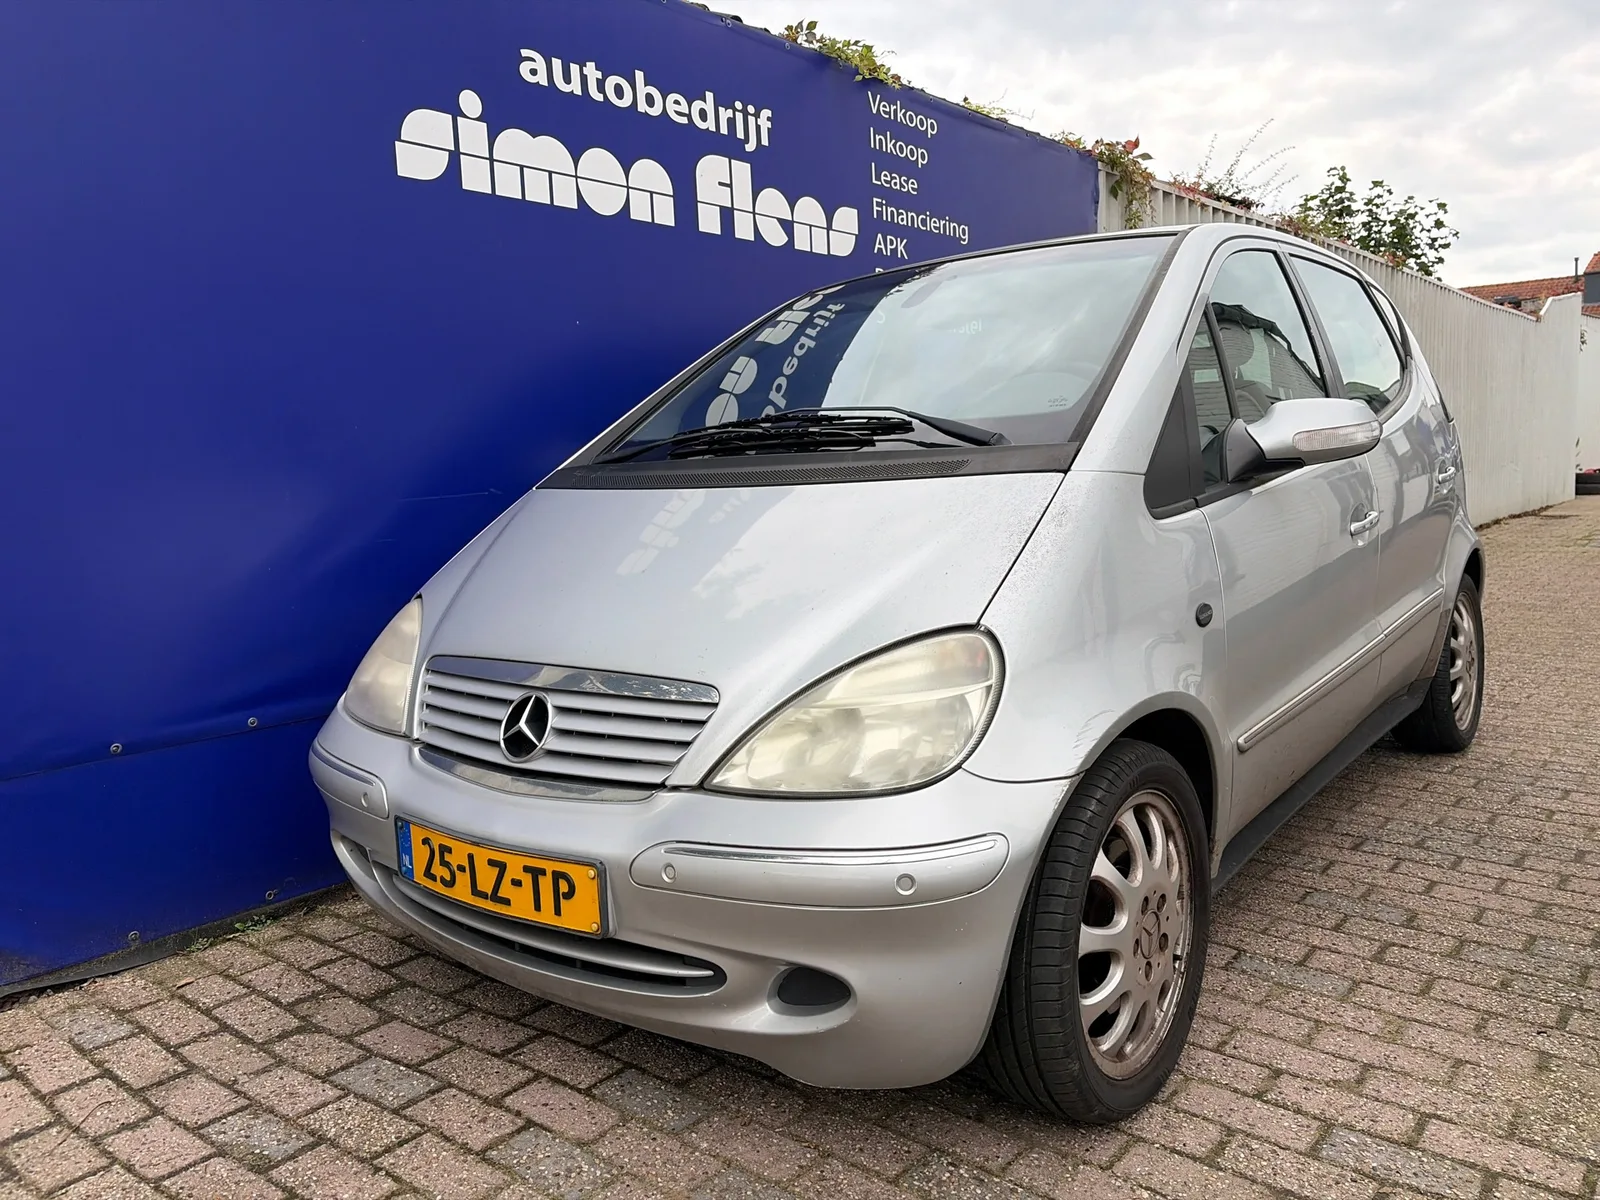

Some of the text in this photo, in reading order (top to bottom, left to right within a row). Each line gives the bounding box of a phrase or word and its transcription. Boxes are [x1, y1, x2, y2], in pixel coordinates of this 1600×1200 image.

[519, 48, 773, 152] autobedrijf
[867, 91, 938, 139] Verkoop
[870, 127, 929, 168] Inkoop
[394, 89, 860, 258] simon flens
[871, 162, 918, 195] Lease
[872, 197, 969, 245] Financiering
[873, 233, 909, 260] APK
[402, 852, 413, 868] NL
[421, 836, 577, 917] 25-LZ-TP
